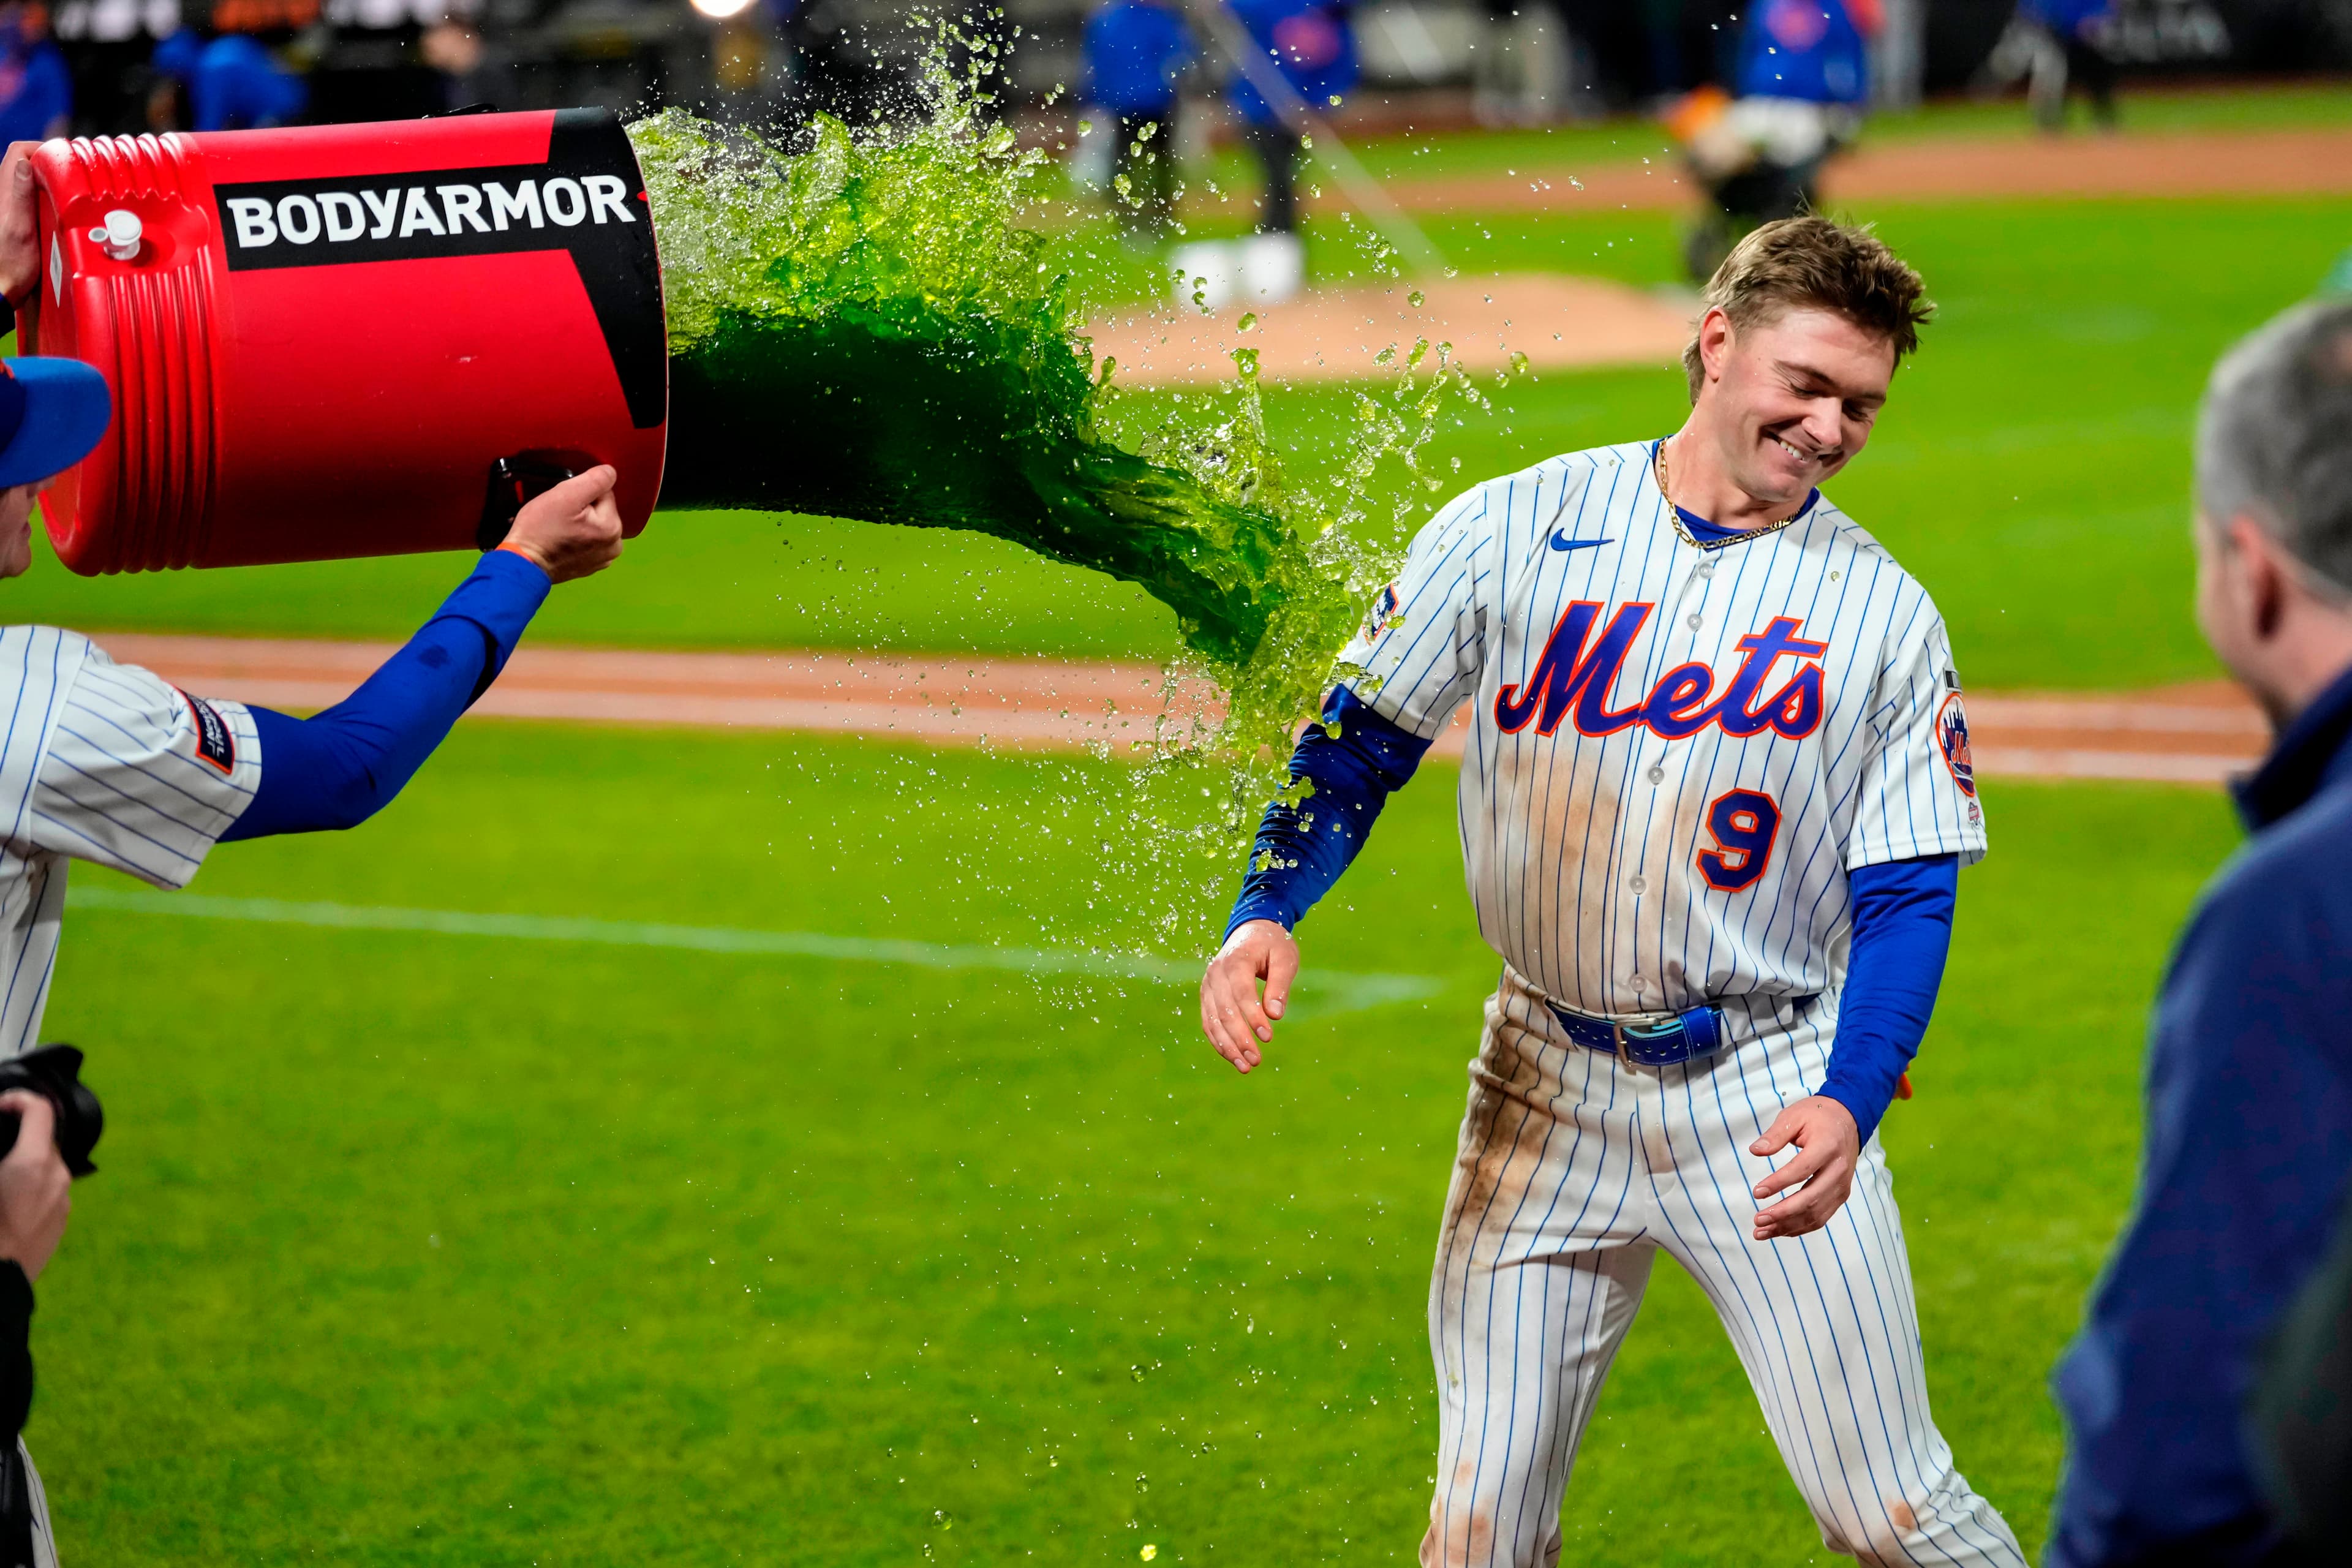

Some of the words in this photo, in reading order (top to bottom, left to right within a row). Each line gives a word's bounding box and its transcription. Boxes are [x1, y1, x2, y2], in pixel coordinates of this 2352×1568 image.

[226, 175, 636, 248] BODYARMOR
[1494, 600, 1830, 741] Mets
[1695, 788, 1782, 893] 9
